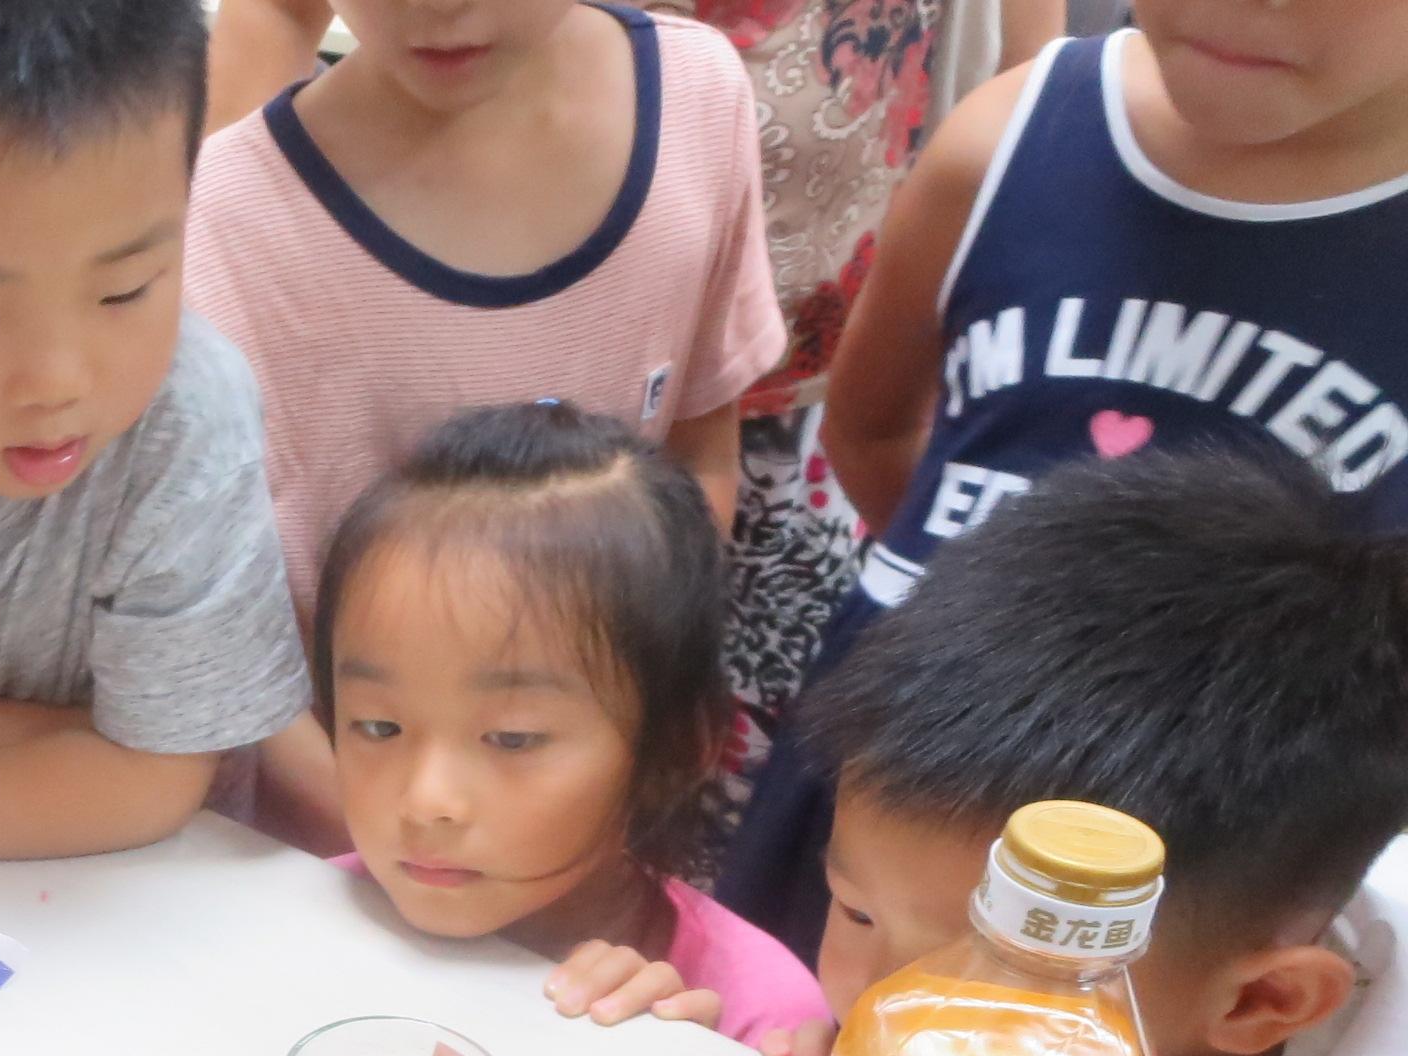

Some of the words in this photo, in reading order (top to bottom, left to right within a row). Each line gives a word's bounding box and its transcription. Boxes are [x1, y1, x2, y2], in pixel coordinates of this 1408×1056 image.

[1044, 297, 1408, 492] LIMITED
[1020, 907, 1136, 949] 金龙鱼
